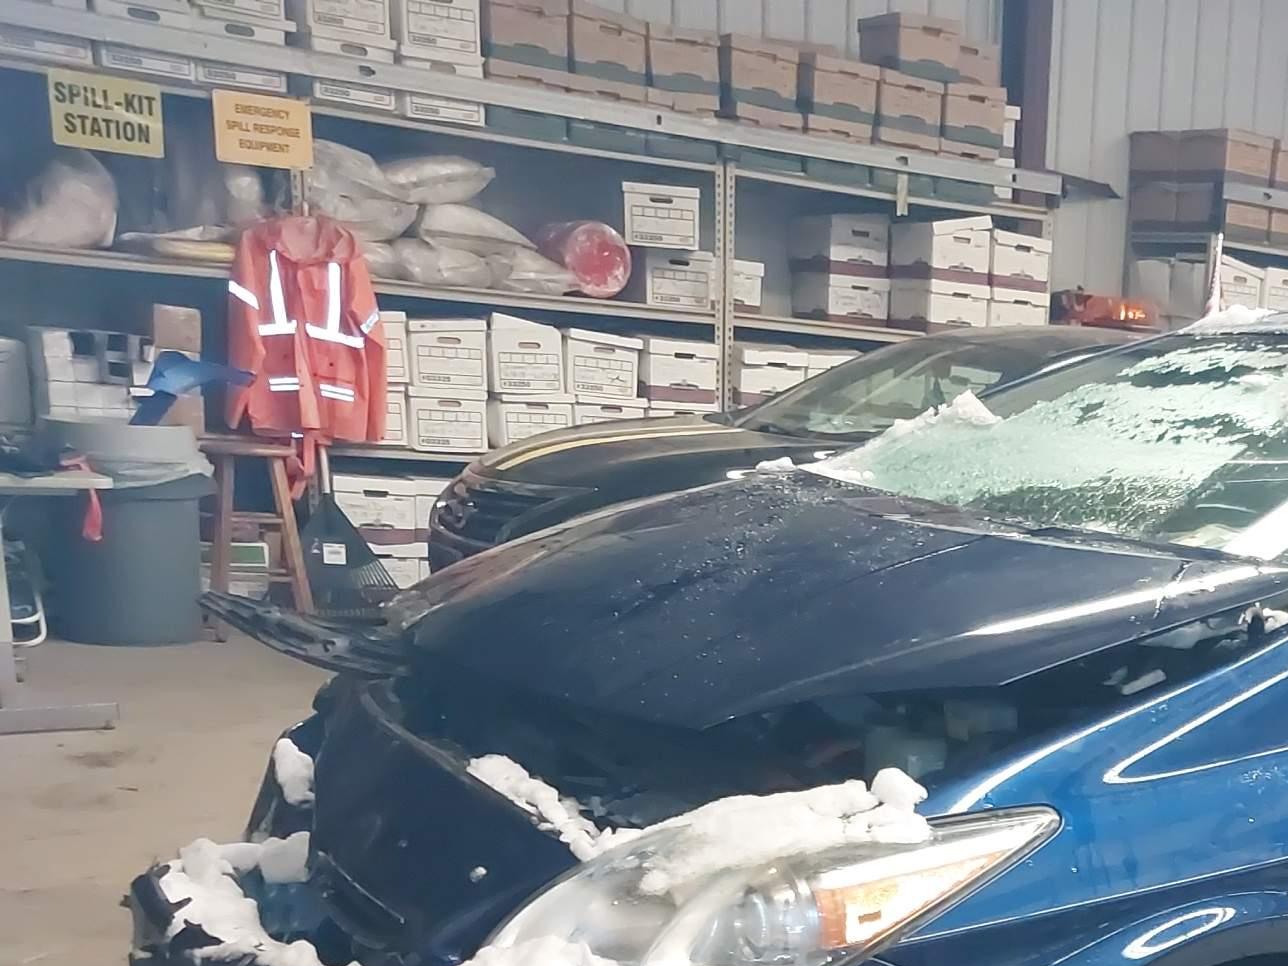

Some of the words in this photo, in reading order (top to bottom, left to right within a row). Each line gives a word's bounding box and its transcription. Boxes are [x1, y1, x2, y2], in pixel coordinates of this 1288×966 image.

[54, 81, 157, 117] SPILL-KIT
[234, 103, 289, 120] EMERGENCY
[64, 112, 151, 144] STATION
[226, 119, 251, 133] SPILL
[252, 123, 301, 139] RESPONSE
[239, 138, 289, 154] EQUIPMENT
